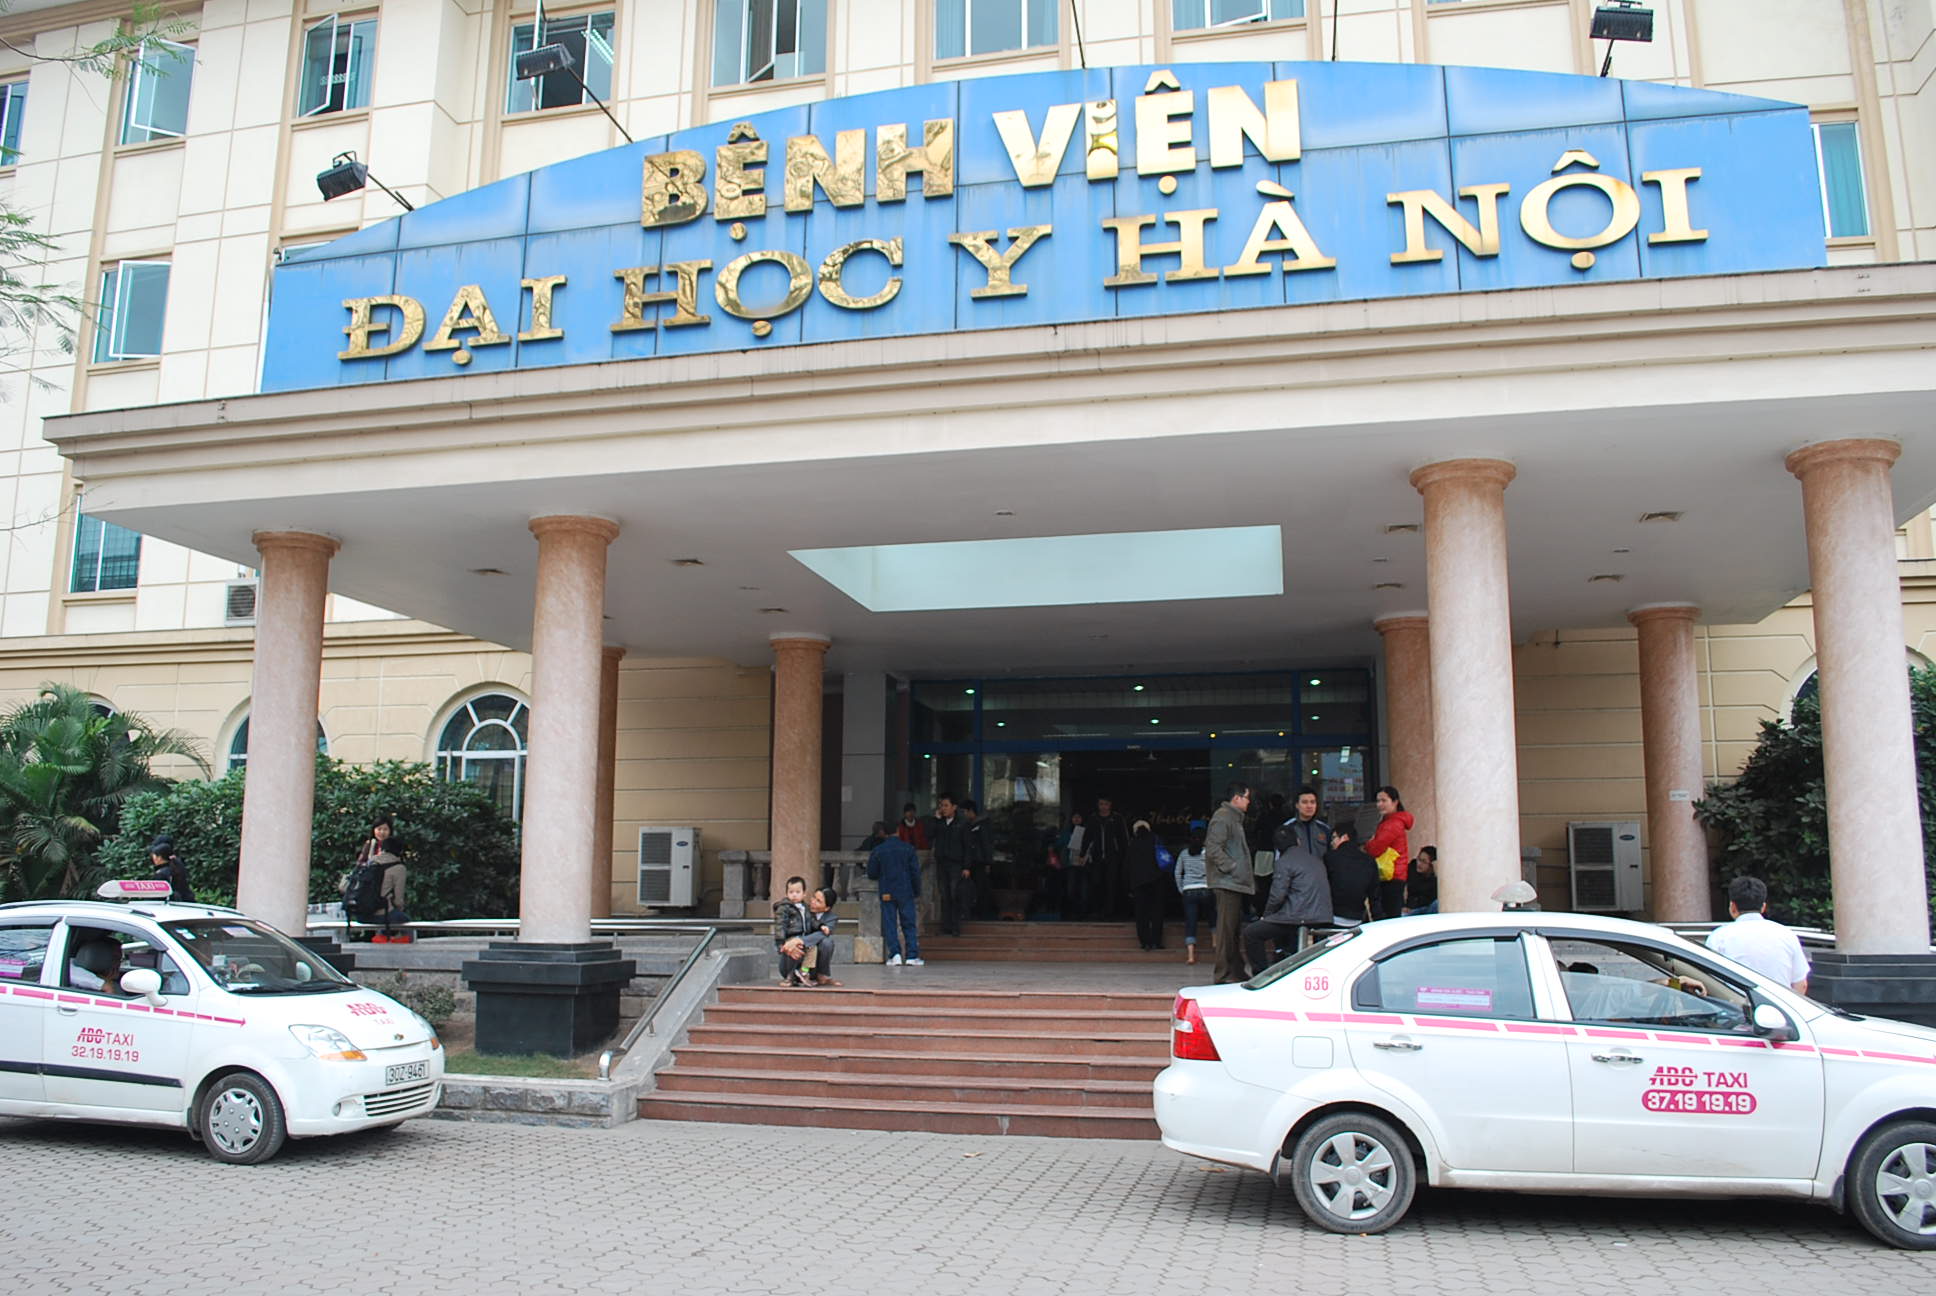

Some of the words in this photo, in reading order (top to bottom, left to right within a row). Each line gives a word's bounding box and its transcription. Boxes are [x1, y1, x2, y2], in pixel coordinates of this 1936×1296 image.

[640, 117, 955, 242] BỆNH
[991, 69, 1301, 196] VIỆN
[338, 274, 568, 366] ĐẠI
[609, 236, 904, 338] HỌC
[948, 224, 1053, 300] Y
[1102, 180, 1338, 288] HÀ
[1386, 149, 1710, 271] NỘI
[1304, 976, 1329, 991] 636
[105, 1032, 134, 1046] TAXI
[71, 1045, 140, 1062] 32.19.19.19
[1649, 1066, 1698, 1087] ABC
[1702, 1072, 1749, 1088] TAXI
